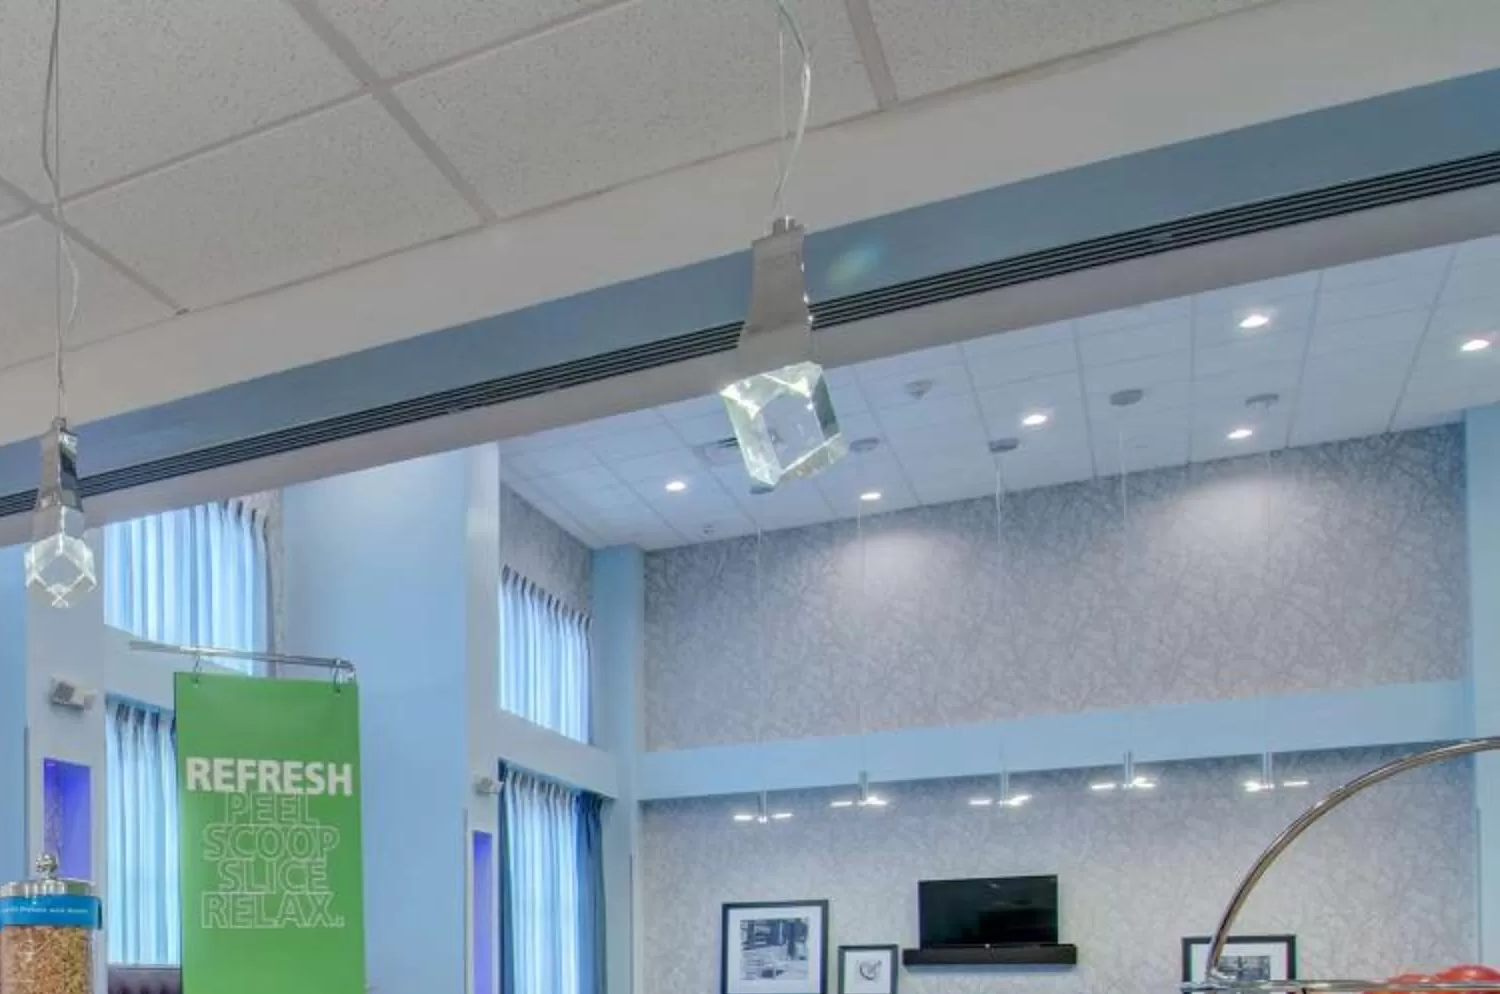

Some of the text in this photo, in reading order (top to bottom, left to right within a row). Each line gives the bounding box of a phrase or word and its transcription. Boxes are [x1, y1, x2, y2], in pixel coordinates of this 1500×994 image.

[185, 756, 353, 796] REFRESH
[225, 792, 320, 826] PEEL
[202, 823, 341, 862] SCOOP
[218, 858, 334, 895] SLICE
